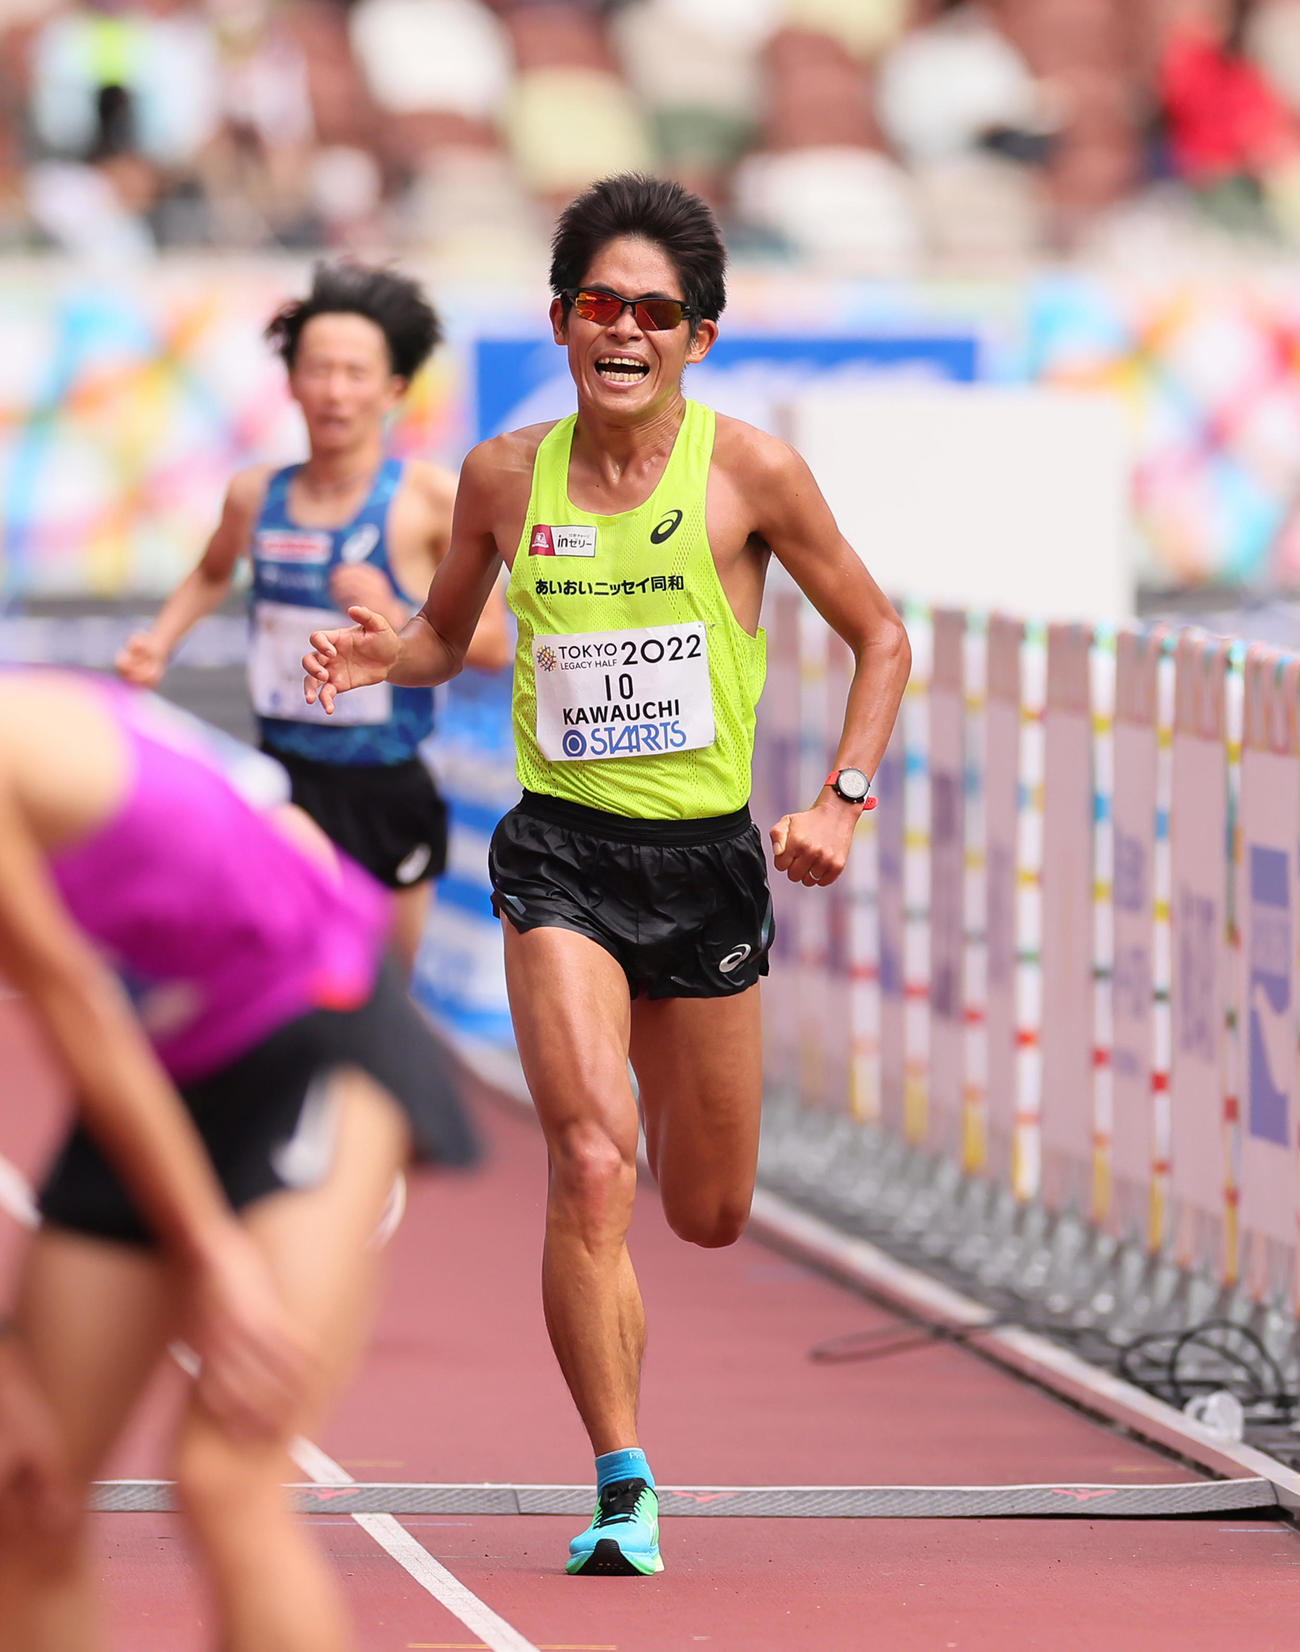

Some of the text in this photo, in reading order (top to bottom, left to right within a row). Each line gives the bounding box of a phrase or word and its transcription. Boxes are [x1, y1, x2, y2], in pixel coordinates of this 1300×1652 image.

[535, 575, 684, 596] あいおいニッセイ同和
[558, 634, 701, 666] TOKYO 2022
[560, 659, 618, 671] LEGACY HALF
[604, 673, 634, 701] 10
[563, 699, 680, 725] KAWAUCHI
